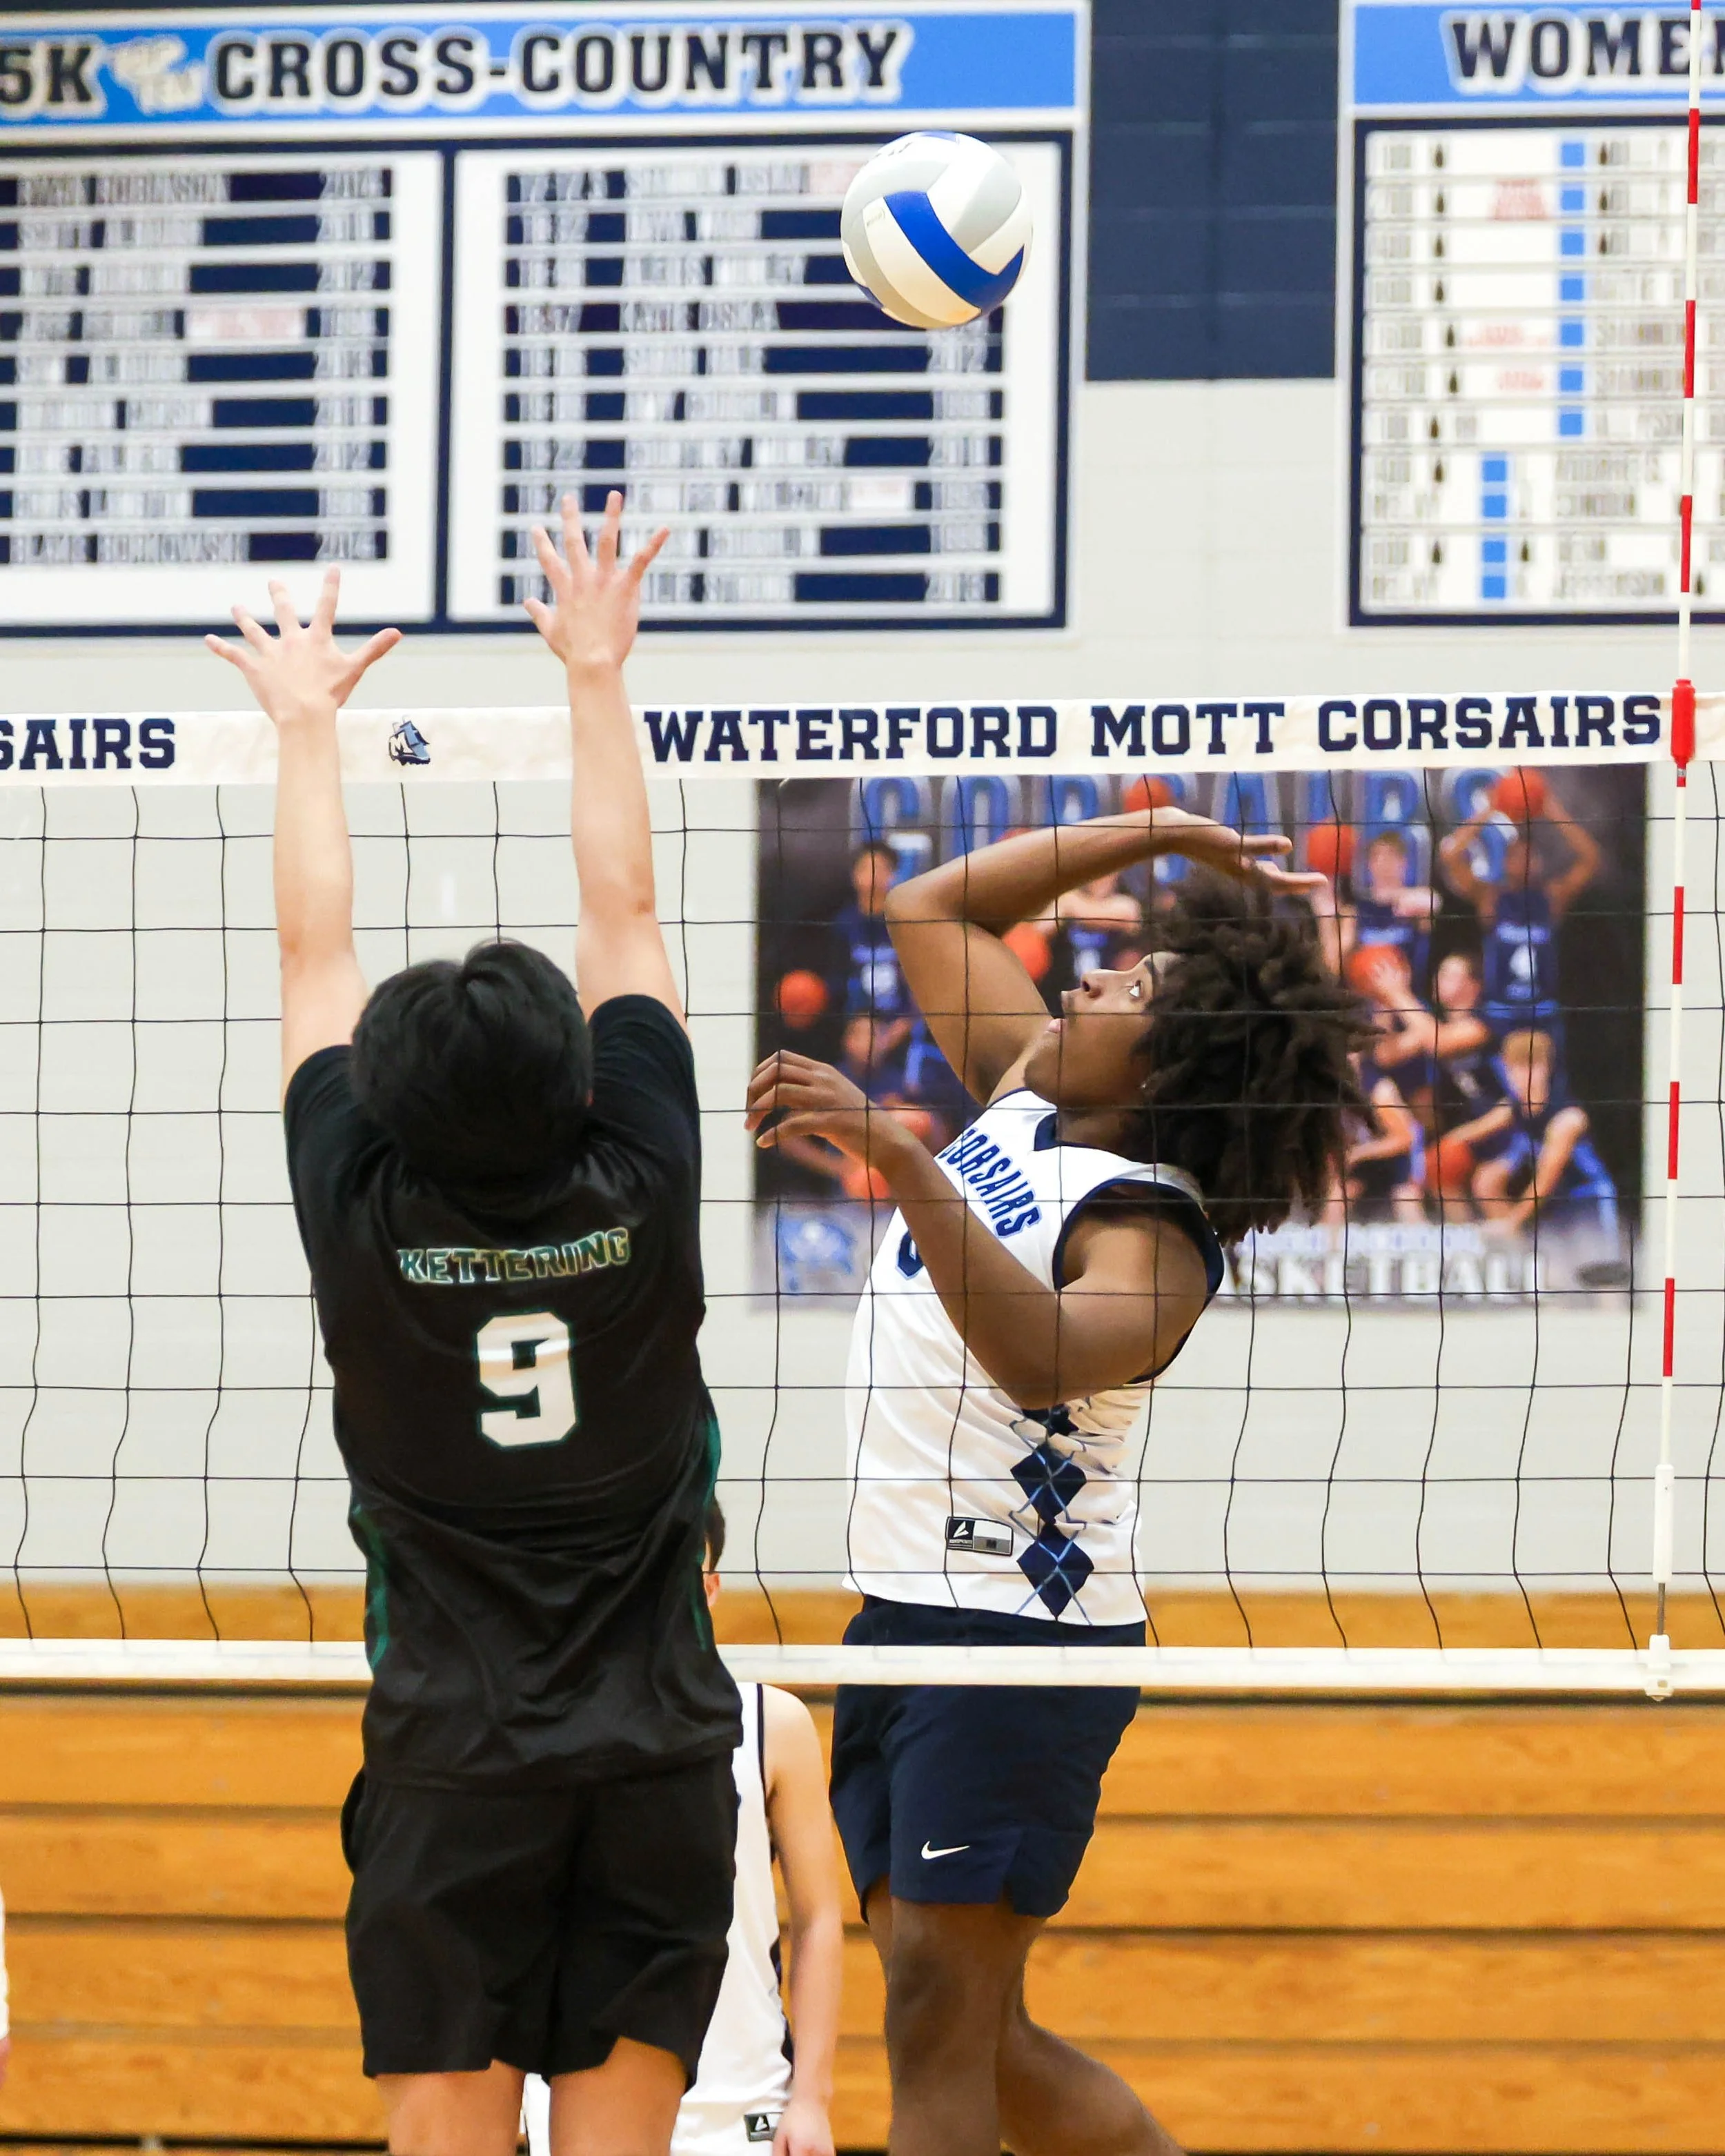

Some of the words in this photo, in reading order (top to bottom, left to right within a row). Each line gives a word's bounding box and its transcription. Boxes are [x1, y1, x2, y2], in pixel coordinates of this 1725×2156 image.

[215, 30, 898, 99] CROSS-COUNTRY
[1452, 20, 1725, 77] WOME
[643, 706, 1057, 762] WATERFORD
[1090, 702, 1285, 757] MOTT
[1319, 695, 1661, 752] CORSAIRS
[397, 1227, 631, 1285] KETTERING
[476, 1312, 577, 1447] 9
